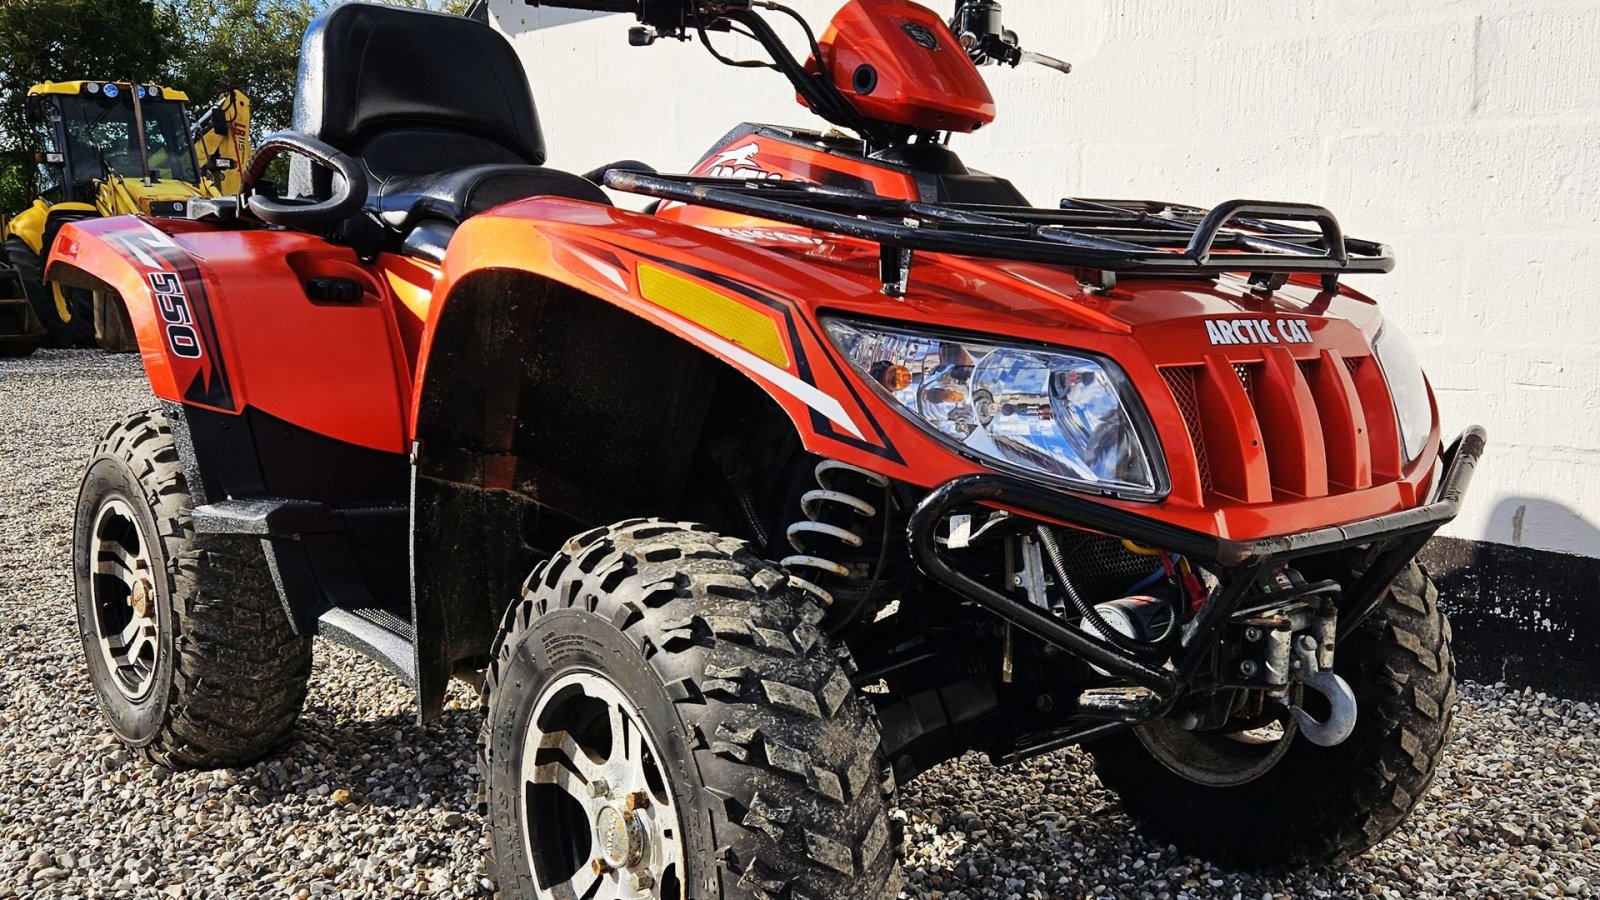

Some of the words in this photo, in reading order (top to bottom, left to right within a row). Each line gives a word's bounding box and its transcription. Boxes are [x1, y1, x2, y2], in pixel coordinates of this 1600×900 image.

[148, 271, 202, 360] 550
[1204, 318, 1280, 345] ARCTIC
[1276, 318, 1315, 344] CAT
